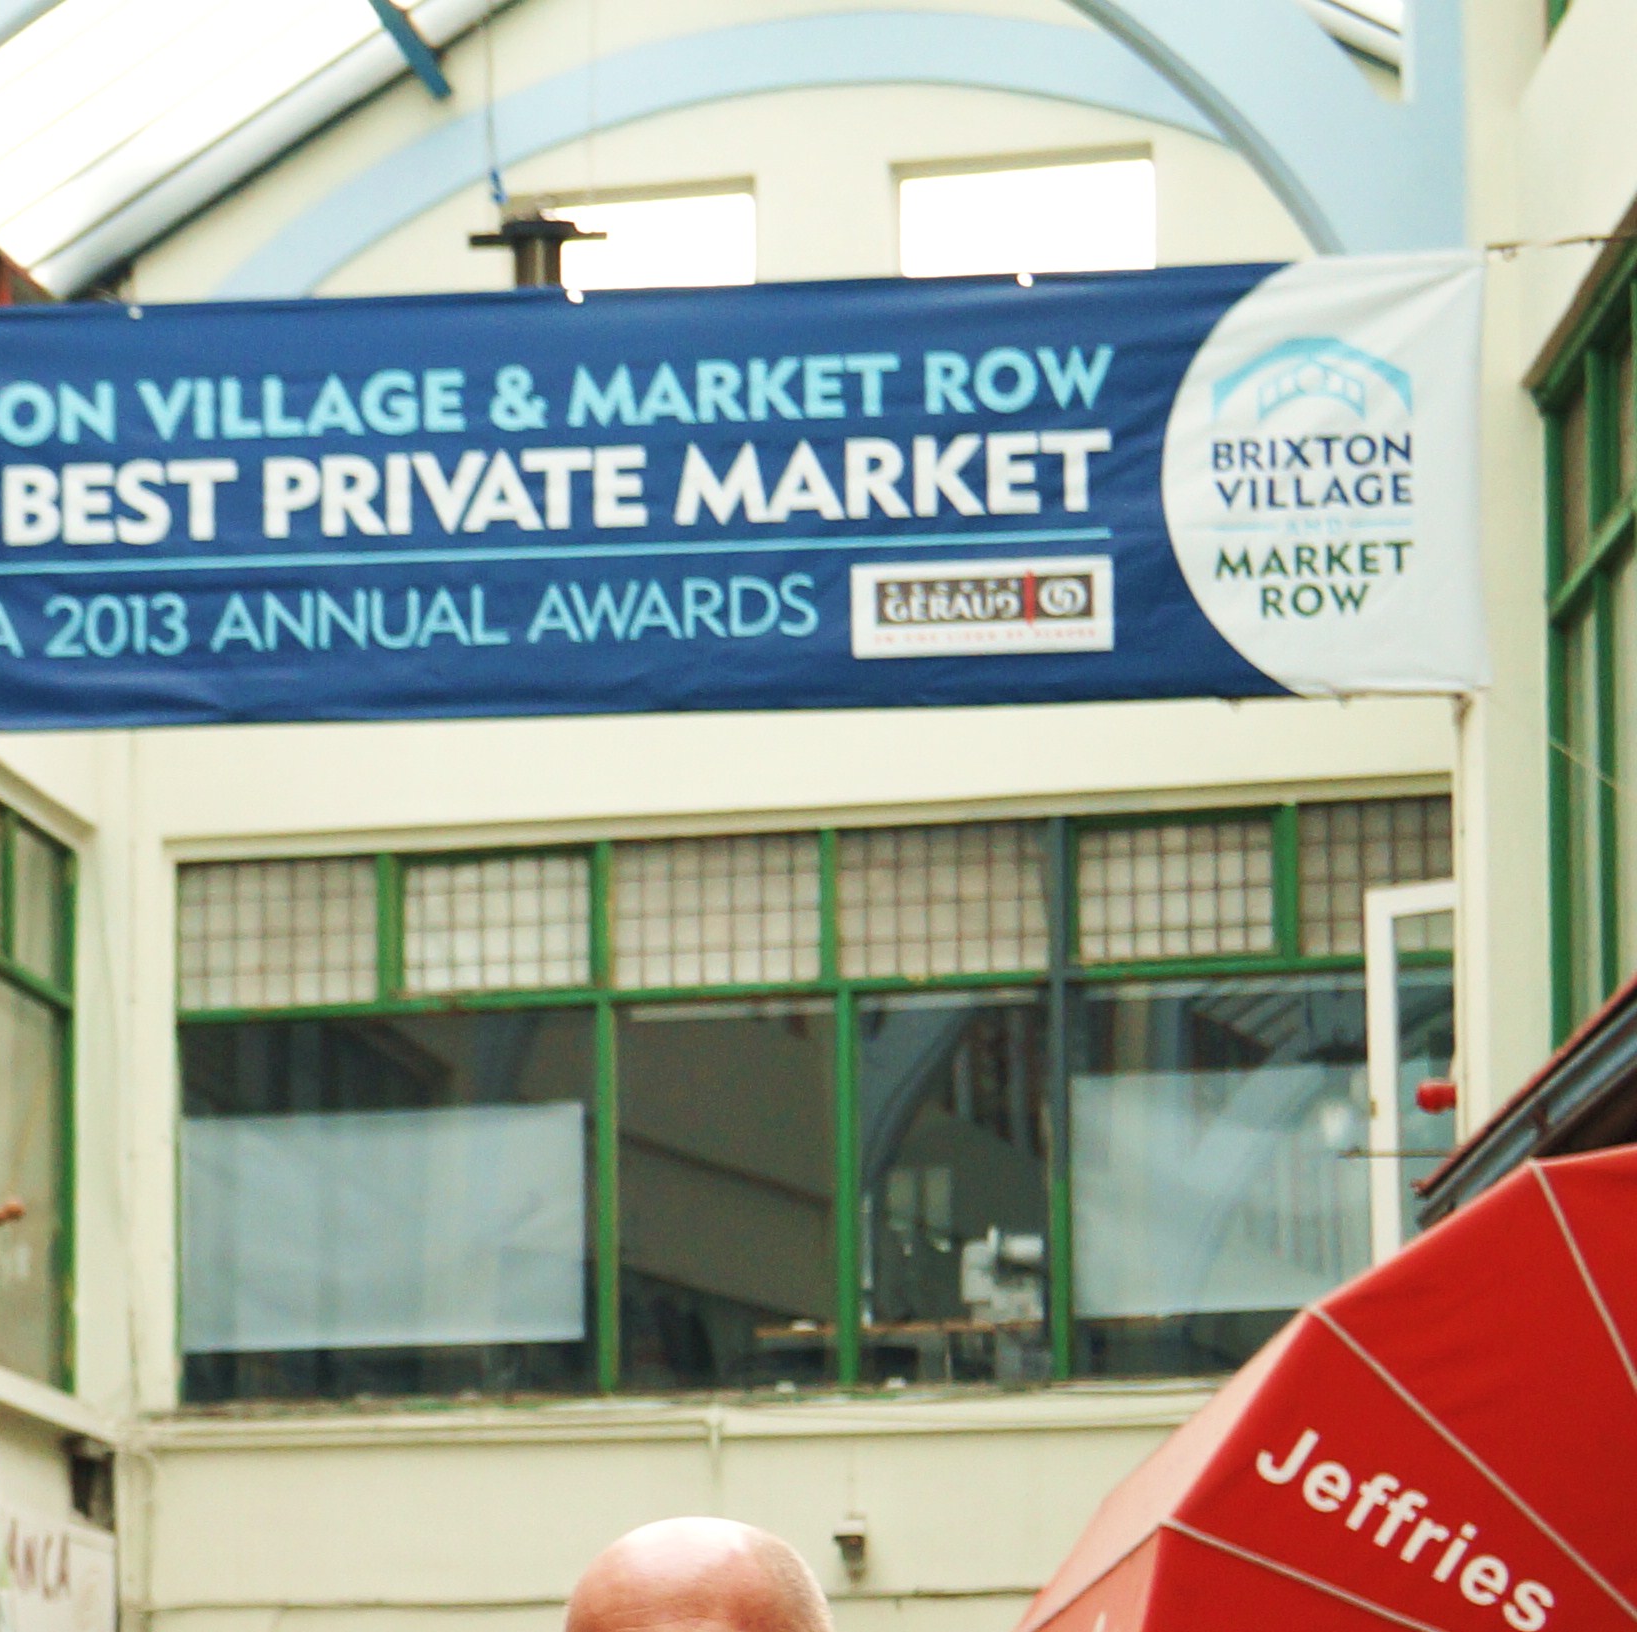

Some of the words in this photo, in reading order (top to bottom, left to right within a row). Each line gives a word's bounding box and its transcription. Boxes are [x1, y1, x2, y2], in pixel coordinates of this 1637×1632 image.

[136, 368, 467, 441] VILLAGE
[489, 364, 548, 432] &
[566, 352, 901, 429] MARKET
[925, 344, 1114, 416] ROW
[1212, 431, 1413, 472] BRIXTON
[1, 457, 239, 547] BEST
[262, 444, 649, 540] PRIVATE
[673, 428, 1113, 527] MARKET
[1215, 472, 1415, 510] VILLAGE
[1214, 540, 1414, 580] MARKET
[42, 592, 190, 658] 2013
[209, 584, 511, 654] ANNUAL
[527, 571, 819, 645] AWARDS
[1260, 583, 1370, 620] ROW
[1255, 1427, 1556, 1632] Jeffries
